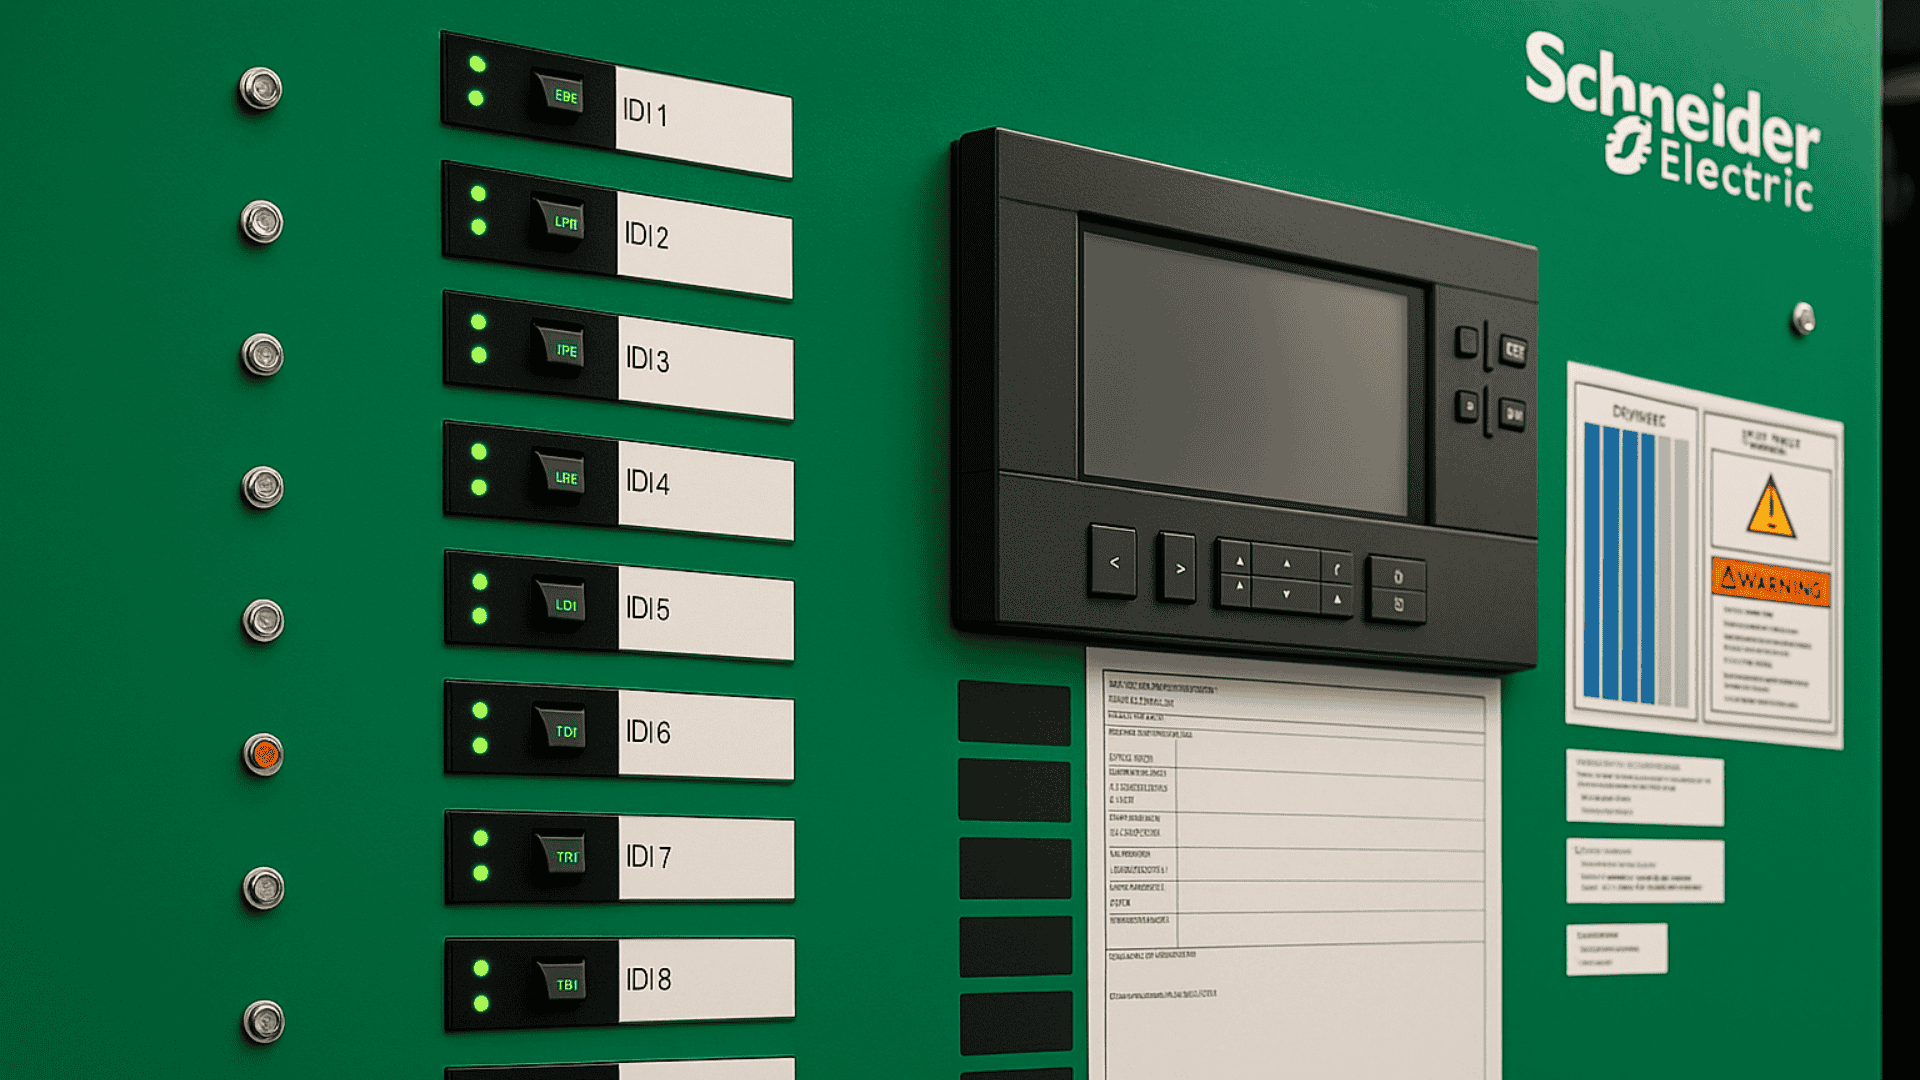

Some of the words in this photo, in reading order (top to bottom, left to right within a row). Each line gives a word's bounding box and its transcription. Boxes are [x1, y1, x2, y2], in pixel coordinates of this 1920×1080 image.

[1525, 29, 1822, 171] Schneider
[1660, 137, 1814, 213] Electric
[1738, 571, 1821, 600] WARNING
